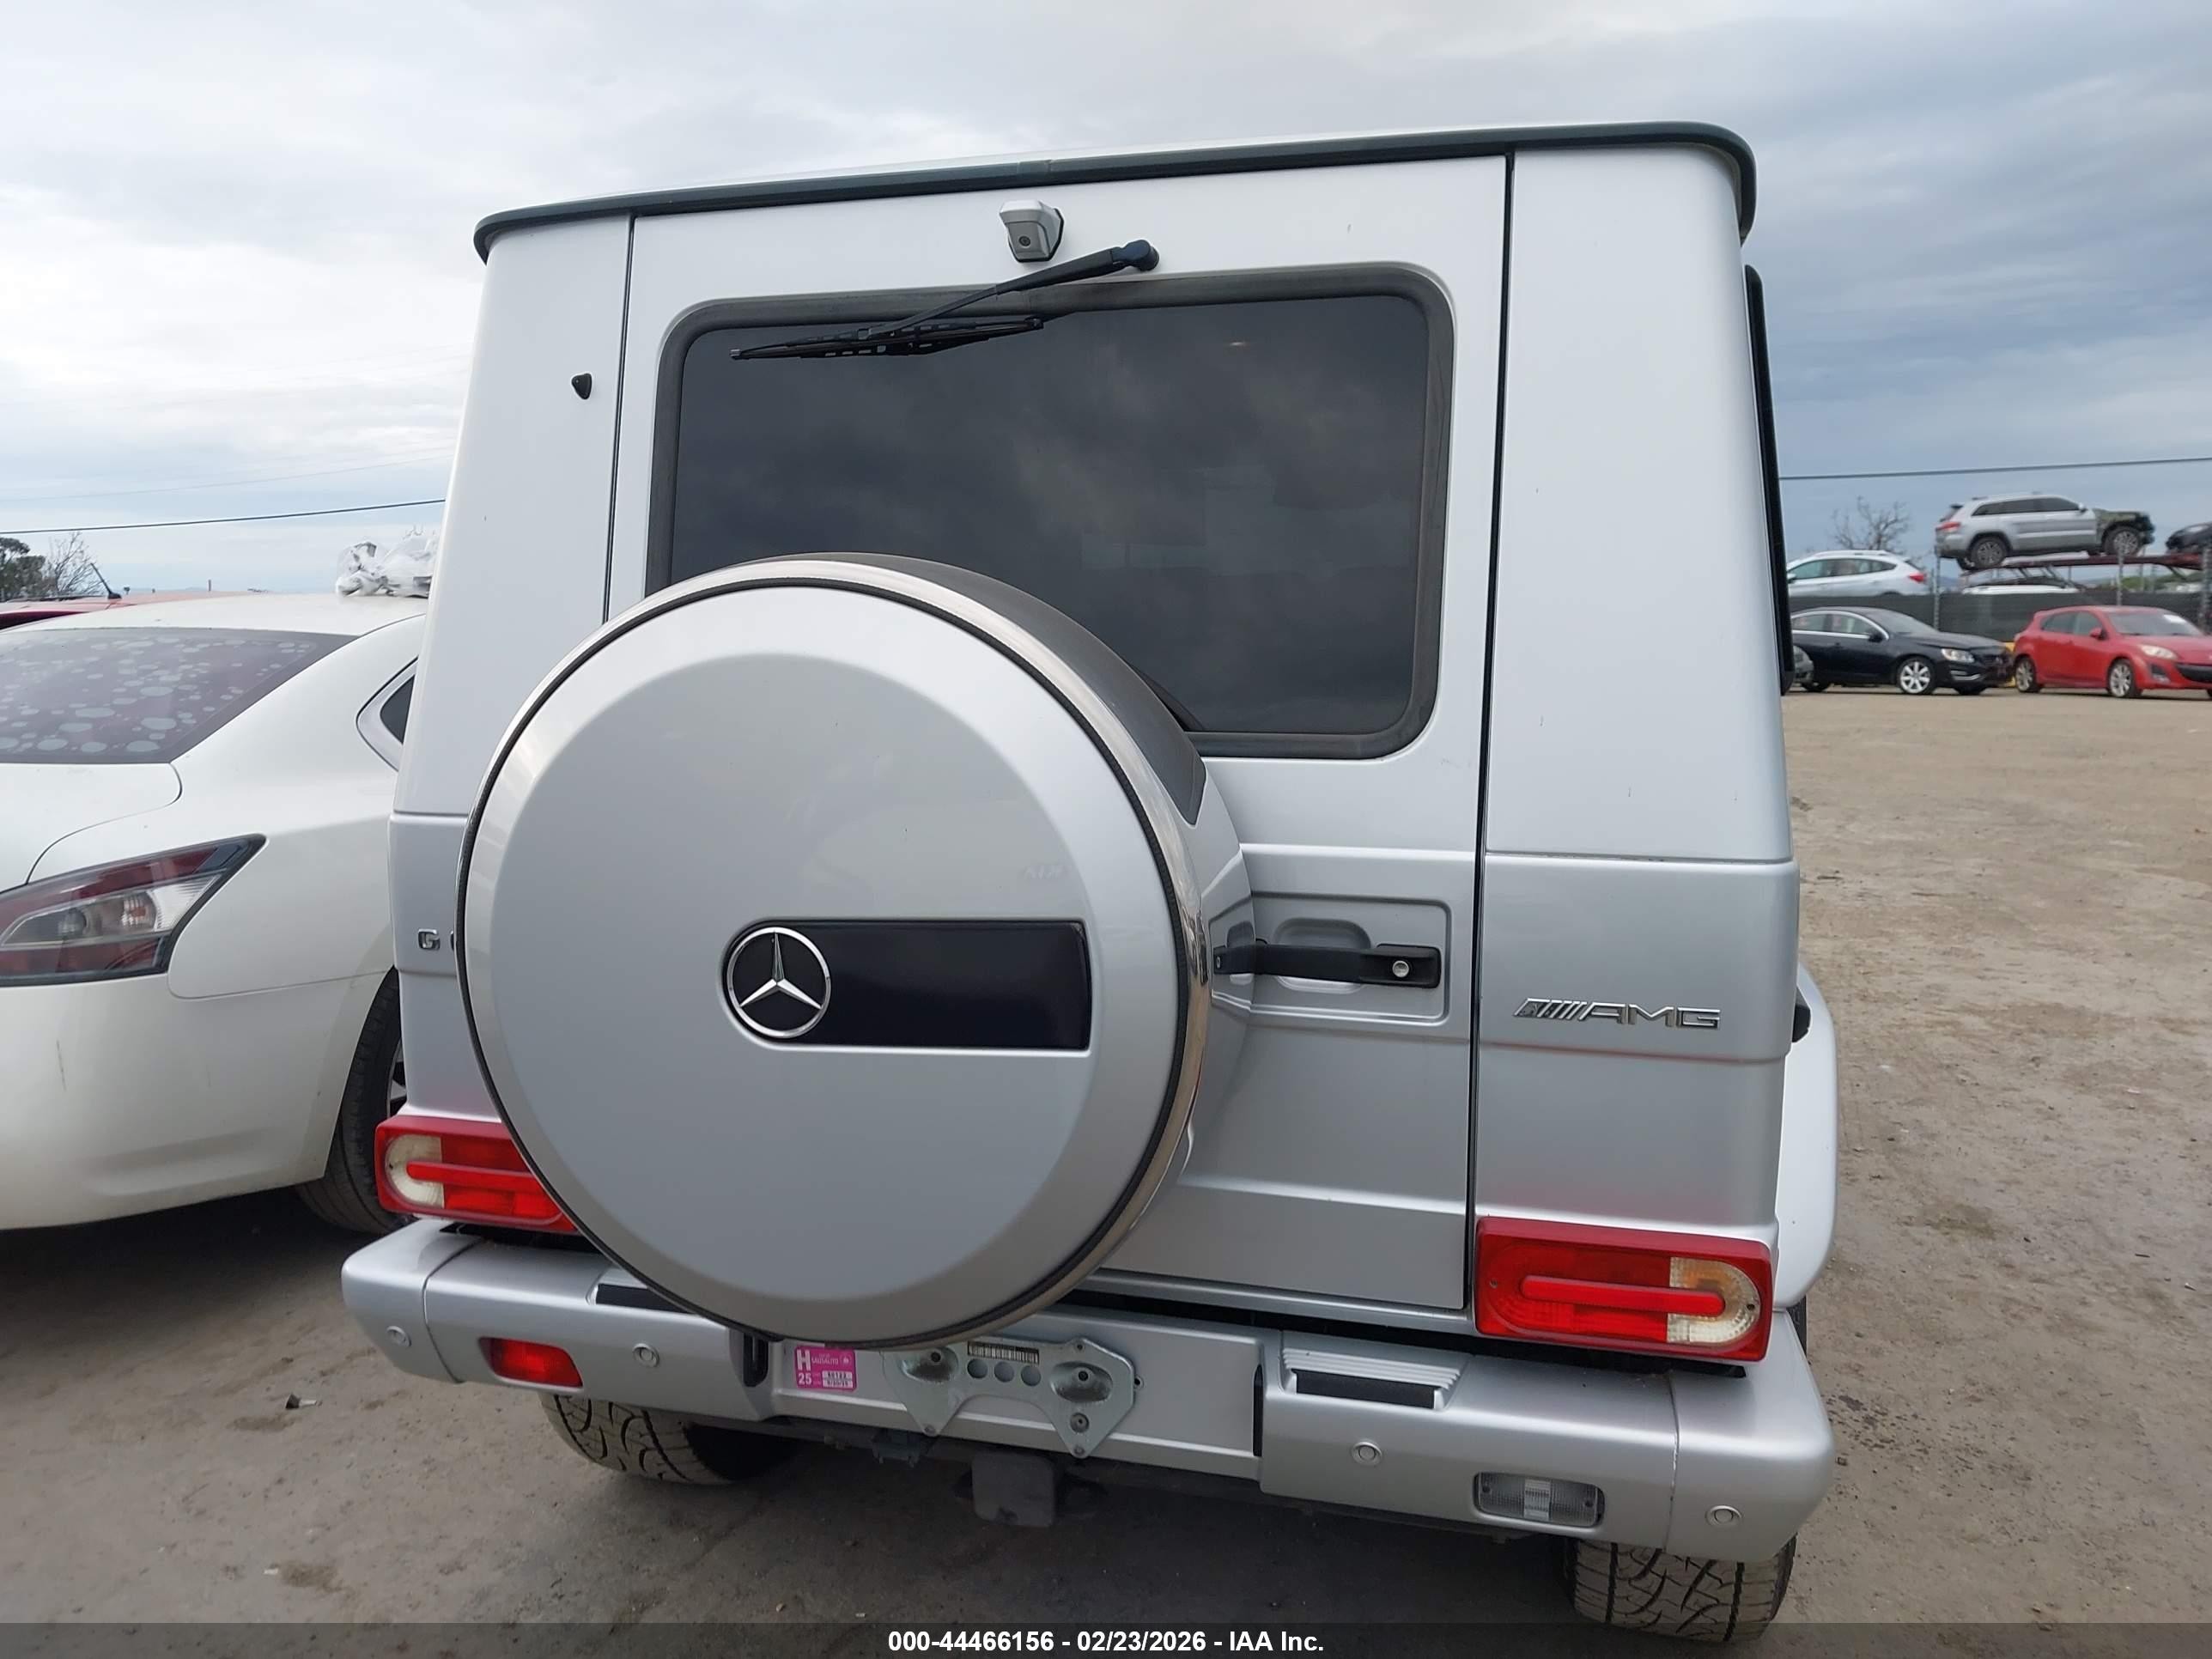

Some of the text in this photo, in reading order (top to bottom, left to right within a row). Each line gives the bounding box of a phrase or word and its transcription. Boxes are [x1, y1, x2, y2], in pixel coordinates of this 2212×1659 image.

[417, 928, 441, 951] G
[1577, 1001, 1721, 1030] AMG
[796, 1349, 811, 1371] H
[798, 1372, 812, 1386] 25
